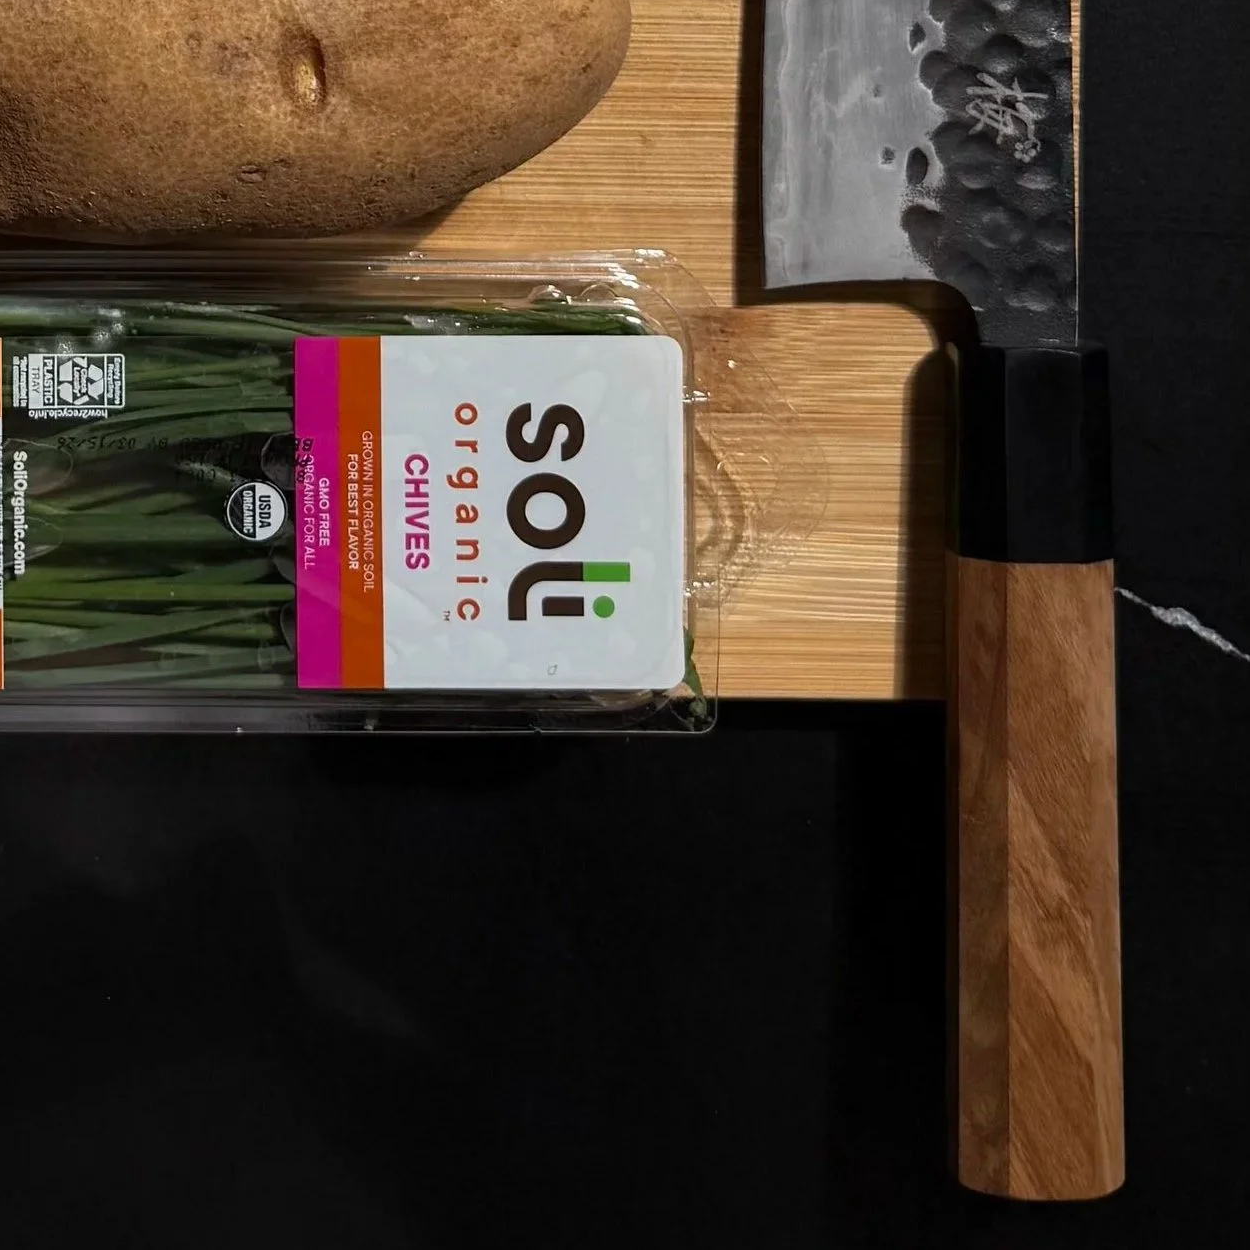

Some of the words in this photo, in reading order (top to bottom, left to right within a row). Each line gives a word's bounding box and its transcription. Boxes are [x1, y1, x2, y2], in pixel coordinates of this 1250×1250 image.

[32, 366, 40, 394] TRAY
[44, 359, 54, 404] PLASTIC
[28, 408, 108, 419] how2recycle.info
[347, 454, 358, 480] FOR
[362, 430, 374, 481] GROWN
[302, 454, 314, 514] ORGANIC
[318, 478, 330, 510] GMO
[347, 482, 358, 516] BEST
[362, 484, 374, 496] IN
[11, 450, 28, 575] SoliOrganic.com
[242, 490, 254, 534] ORGANIC
[258, 494, 271, 529] USDA
[404, 454, 430, 570] CHIVES
[446, 402, 488, 621] organic
[506, 402, 631, 622] soli
[304, 517, 315, 542] FOR
[318, 513, 330, 546] FREE
[348, 518, 360, 570] FLAVOR
[362, 500, 374, 562] ORGANIC
[304, 546, 316, 570] ALL
[363, 563, 375, 592] SOIL
